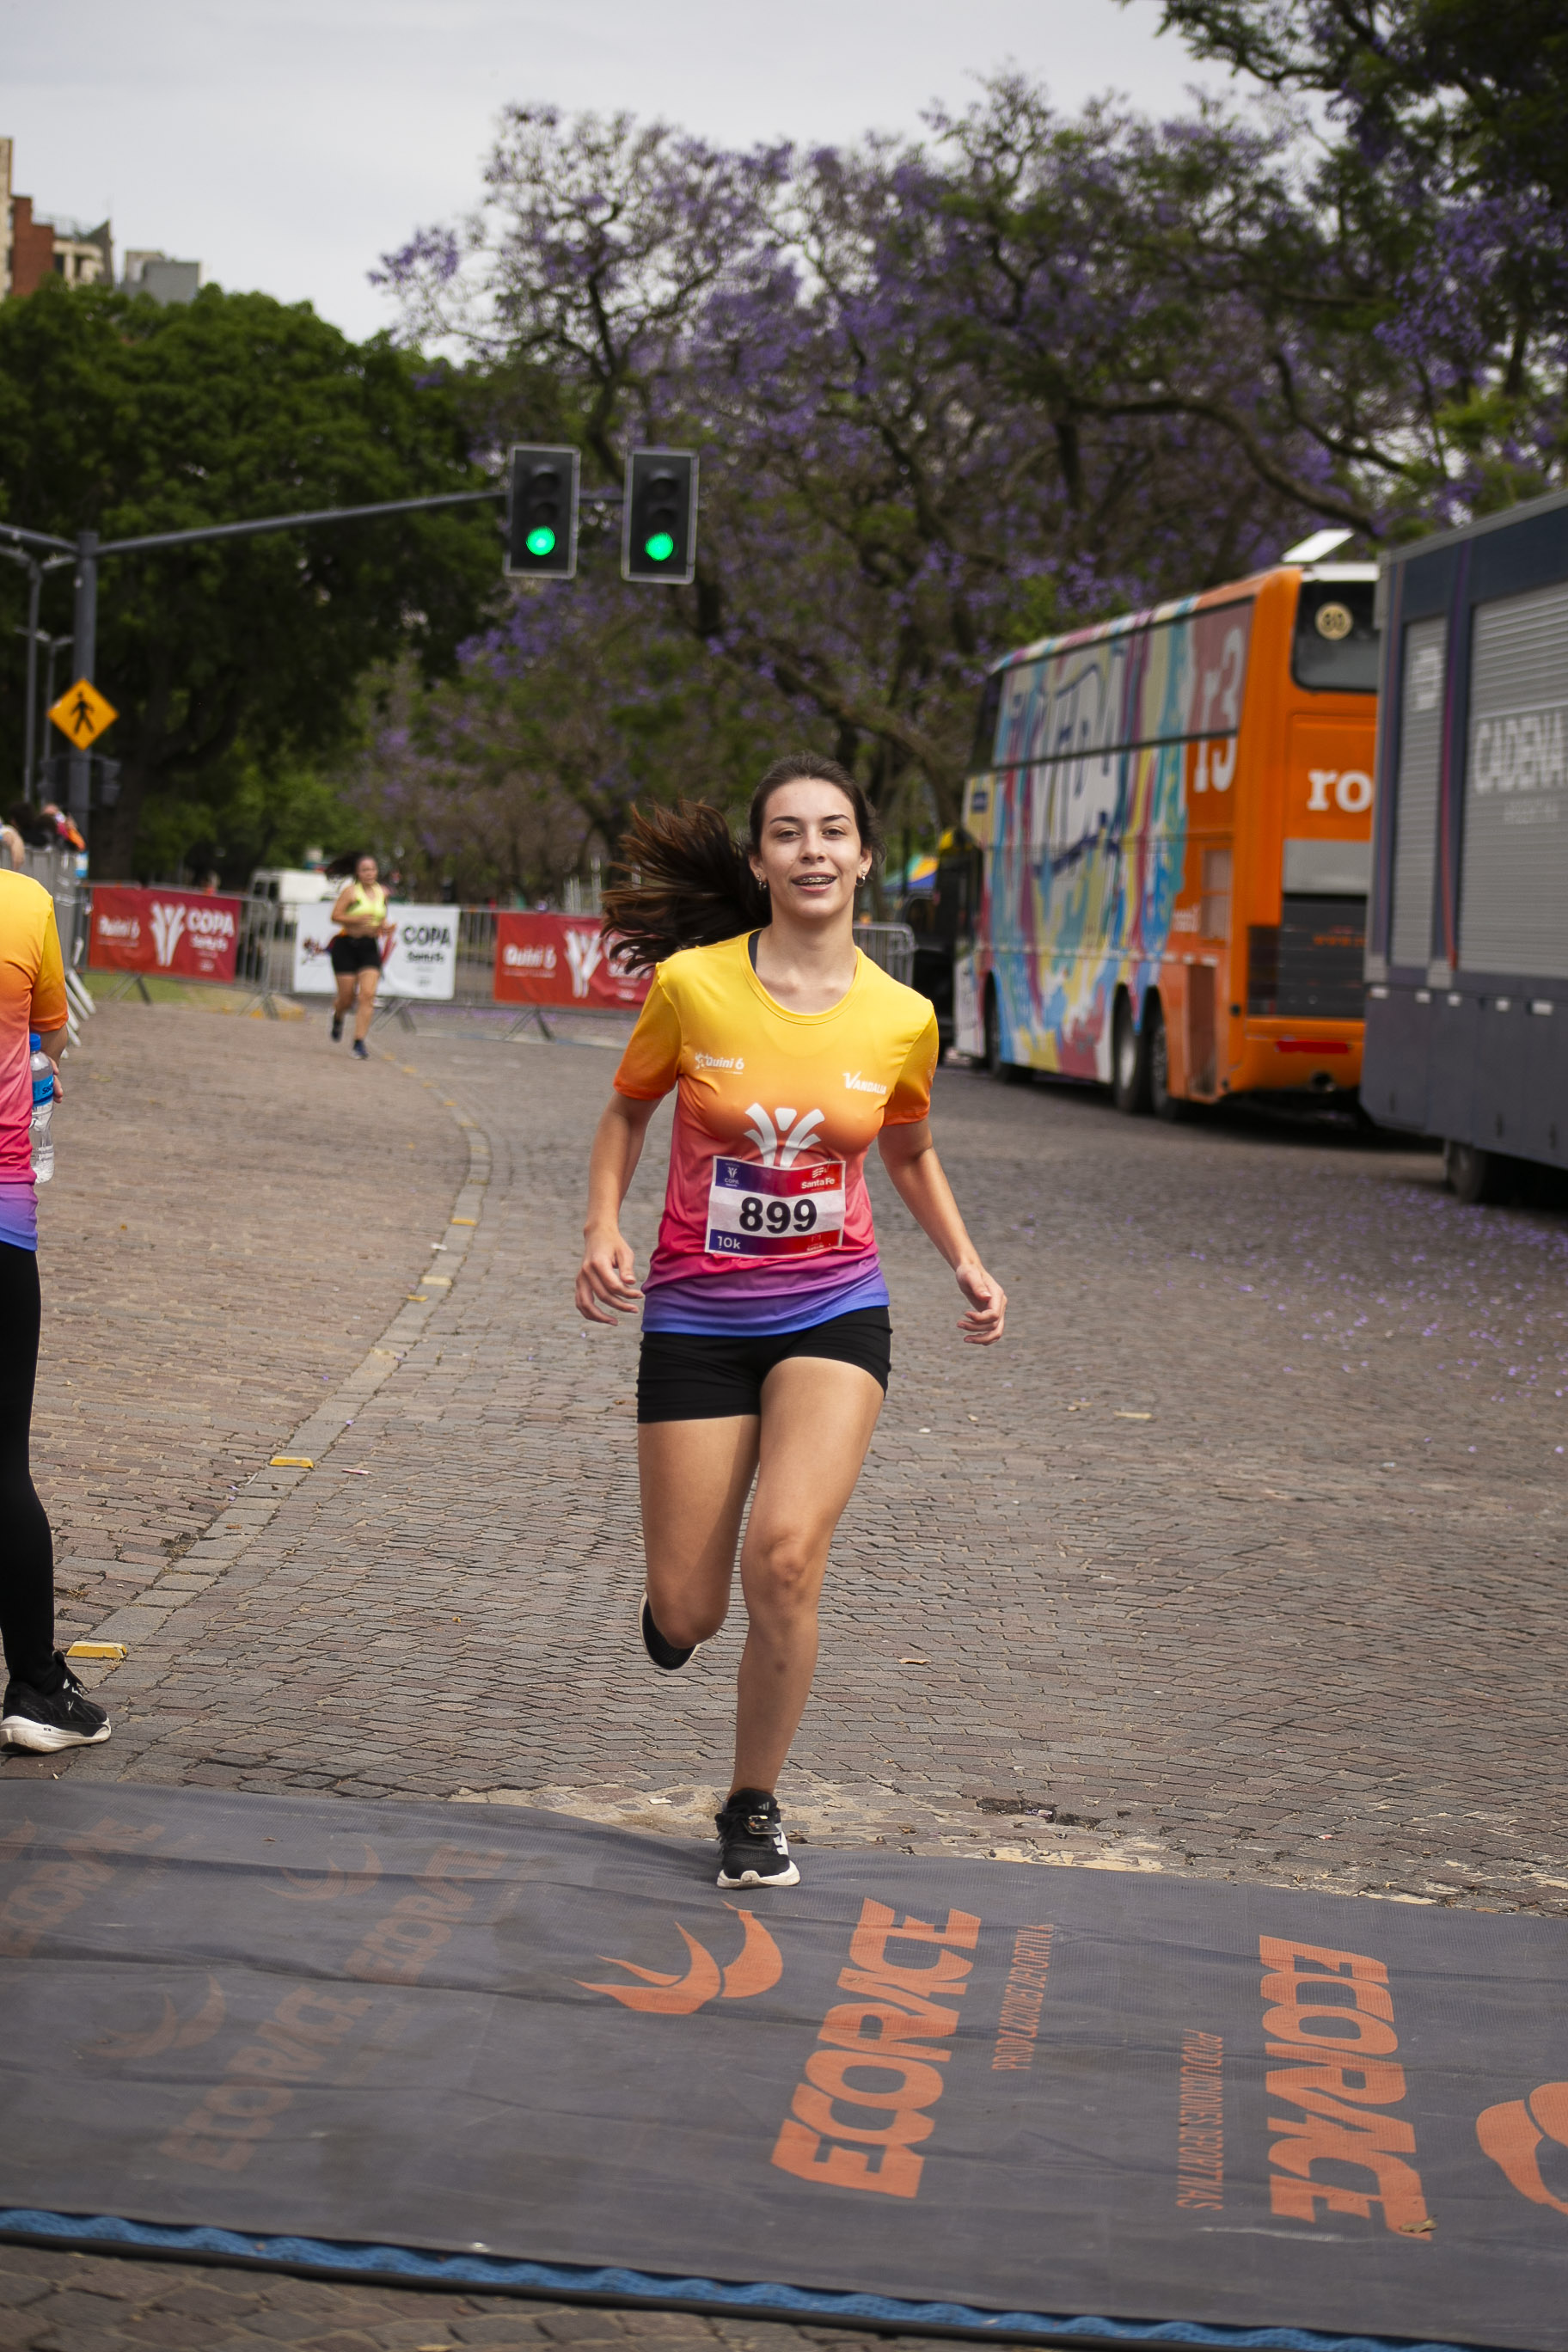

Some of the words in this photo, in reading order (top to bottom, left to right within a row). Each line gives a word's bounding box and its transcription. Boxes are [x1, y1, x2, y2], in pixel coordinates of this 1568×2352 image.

[187, 907, 235, 937] COPA
[403, 925, 450, 946] COPA
[735, 1057, 744, 1070] 6
[801, 1179, 824, 1189] Santa
[825, 1177, 836, 1185] Fe
[738, 1196, 818, 1234] 899
[717, 1236, 741, 1250] 10k
[770, 1897, 982, 2199] ECORACE
[1179, 2028, 1223, 2126] PRODUCCIONES
[1259, 1933, 1433, 2242] ECORACE
[1175, 2127, 1223, 2212] DEPORTIVAS
